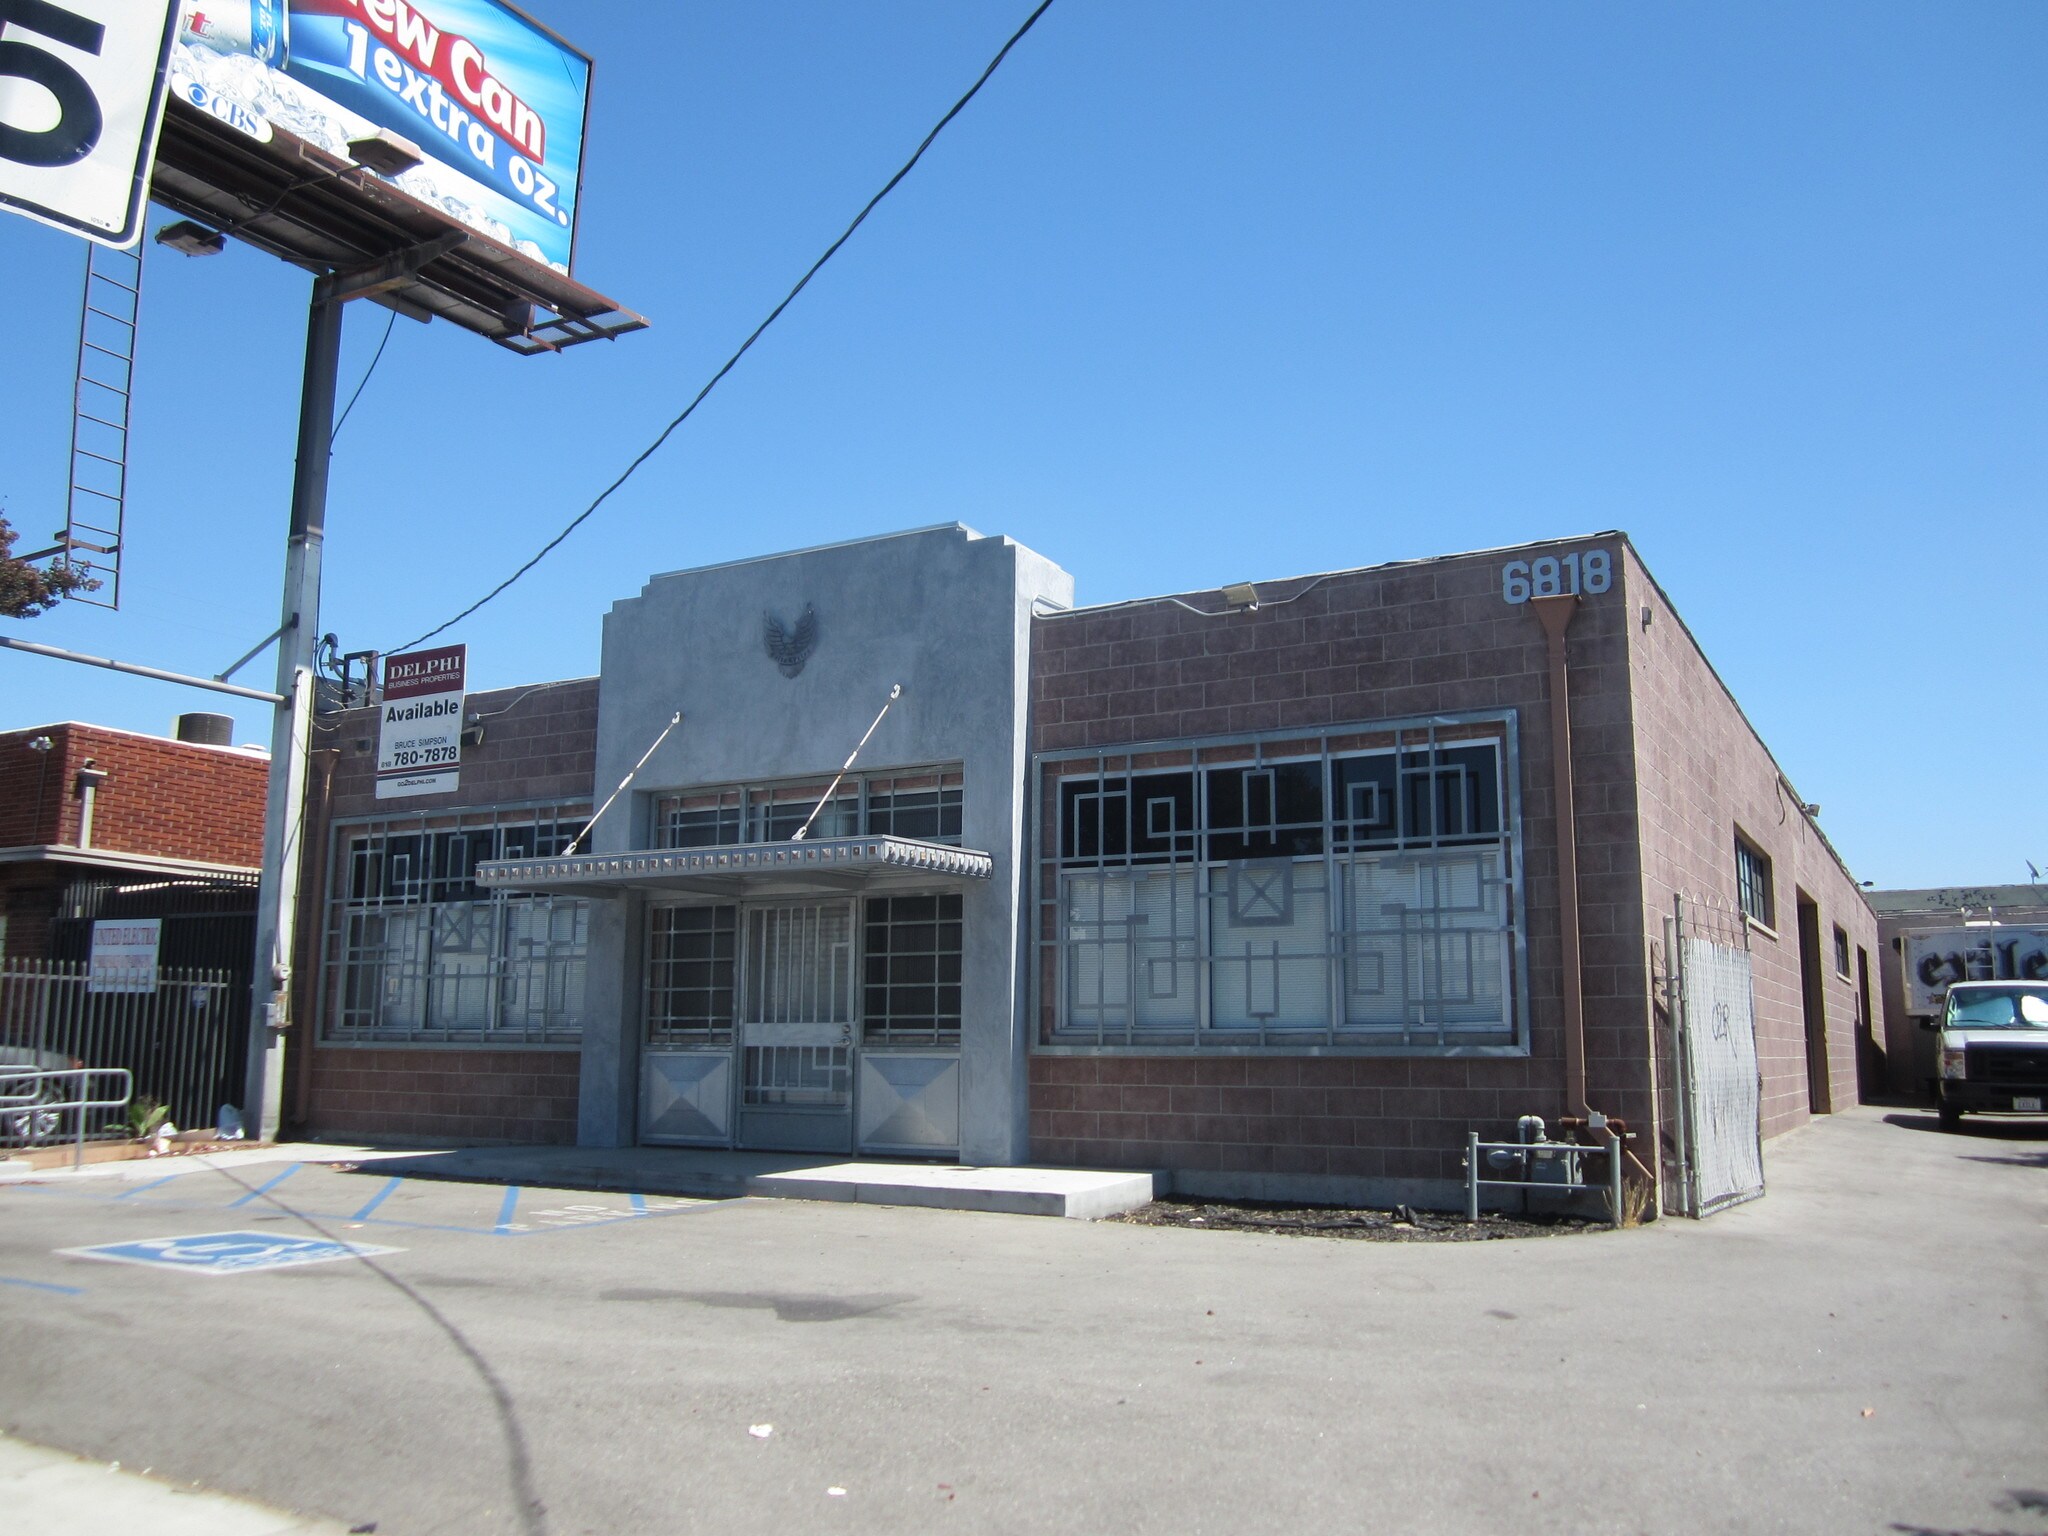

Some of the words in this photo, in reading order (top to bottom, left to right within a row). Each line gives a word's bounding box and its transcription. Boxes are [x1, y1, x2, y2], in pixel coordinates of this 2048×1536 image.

[0, 0, 106, 167] 5
[349, 0, 440, 69] ew
[450, 39, 542, 160] Can
[212, 96, 258, 135] CBS
[348, 22, 368, 80] 1
[374, 47, 494, 170] extra
[509, 155, 568, 226] oz.
[1502, 549, 1612, 604] 6818
[388, 679, 419, 689] BUSINESS
[421, 672, 460, 684] PROPERTIES
[390, 656, 460, 680] DELPHI
[386, 699, 459, 723] Available
[393, 746, 457, 767] 780-7878
[395, 740, 415, 749] BRUCE
[418, 736, 447, 746] SIMPSON
